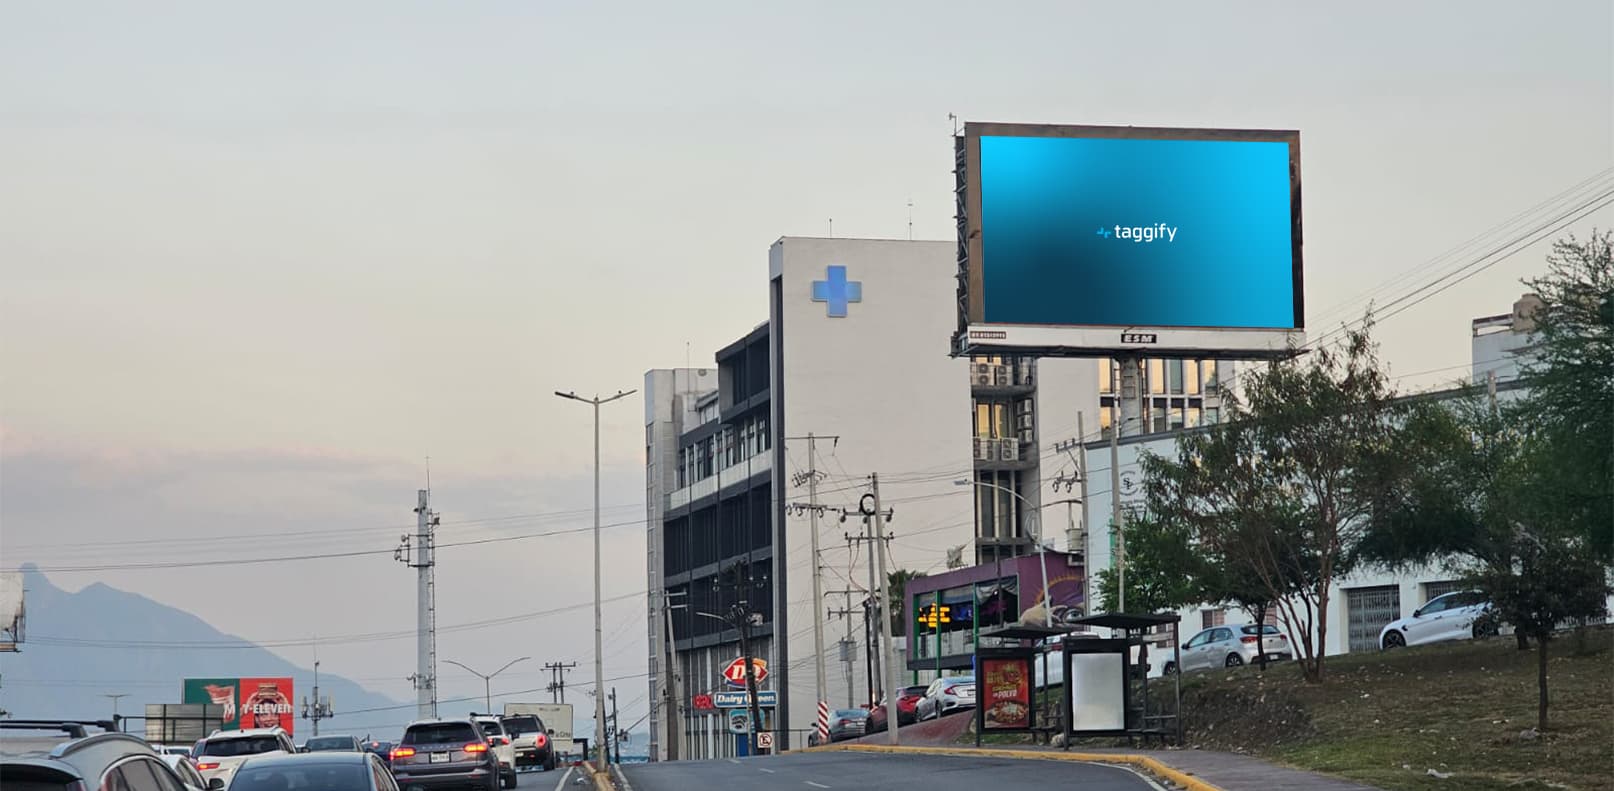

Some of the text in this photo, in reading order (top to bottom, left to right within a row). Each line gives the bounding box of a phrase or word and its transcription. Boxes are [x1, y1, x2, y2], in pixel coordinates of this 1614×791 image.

[1114, 223, 1178, 242] taggify
[1124, 334, 1154, 344] ESM
[717, 694, 743, 704] Dairy
[744, 694, 775, 704] Qeen
